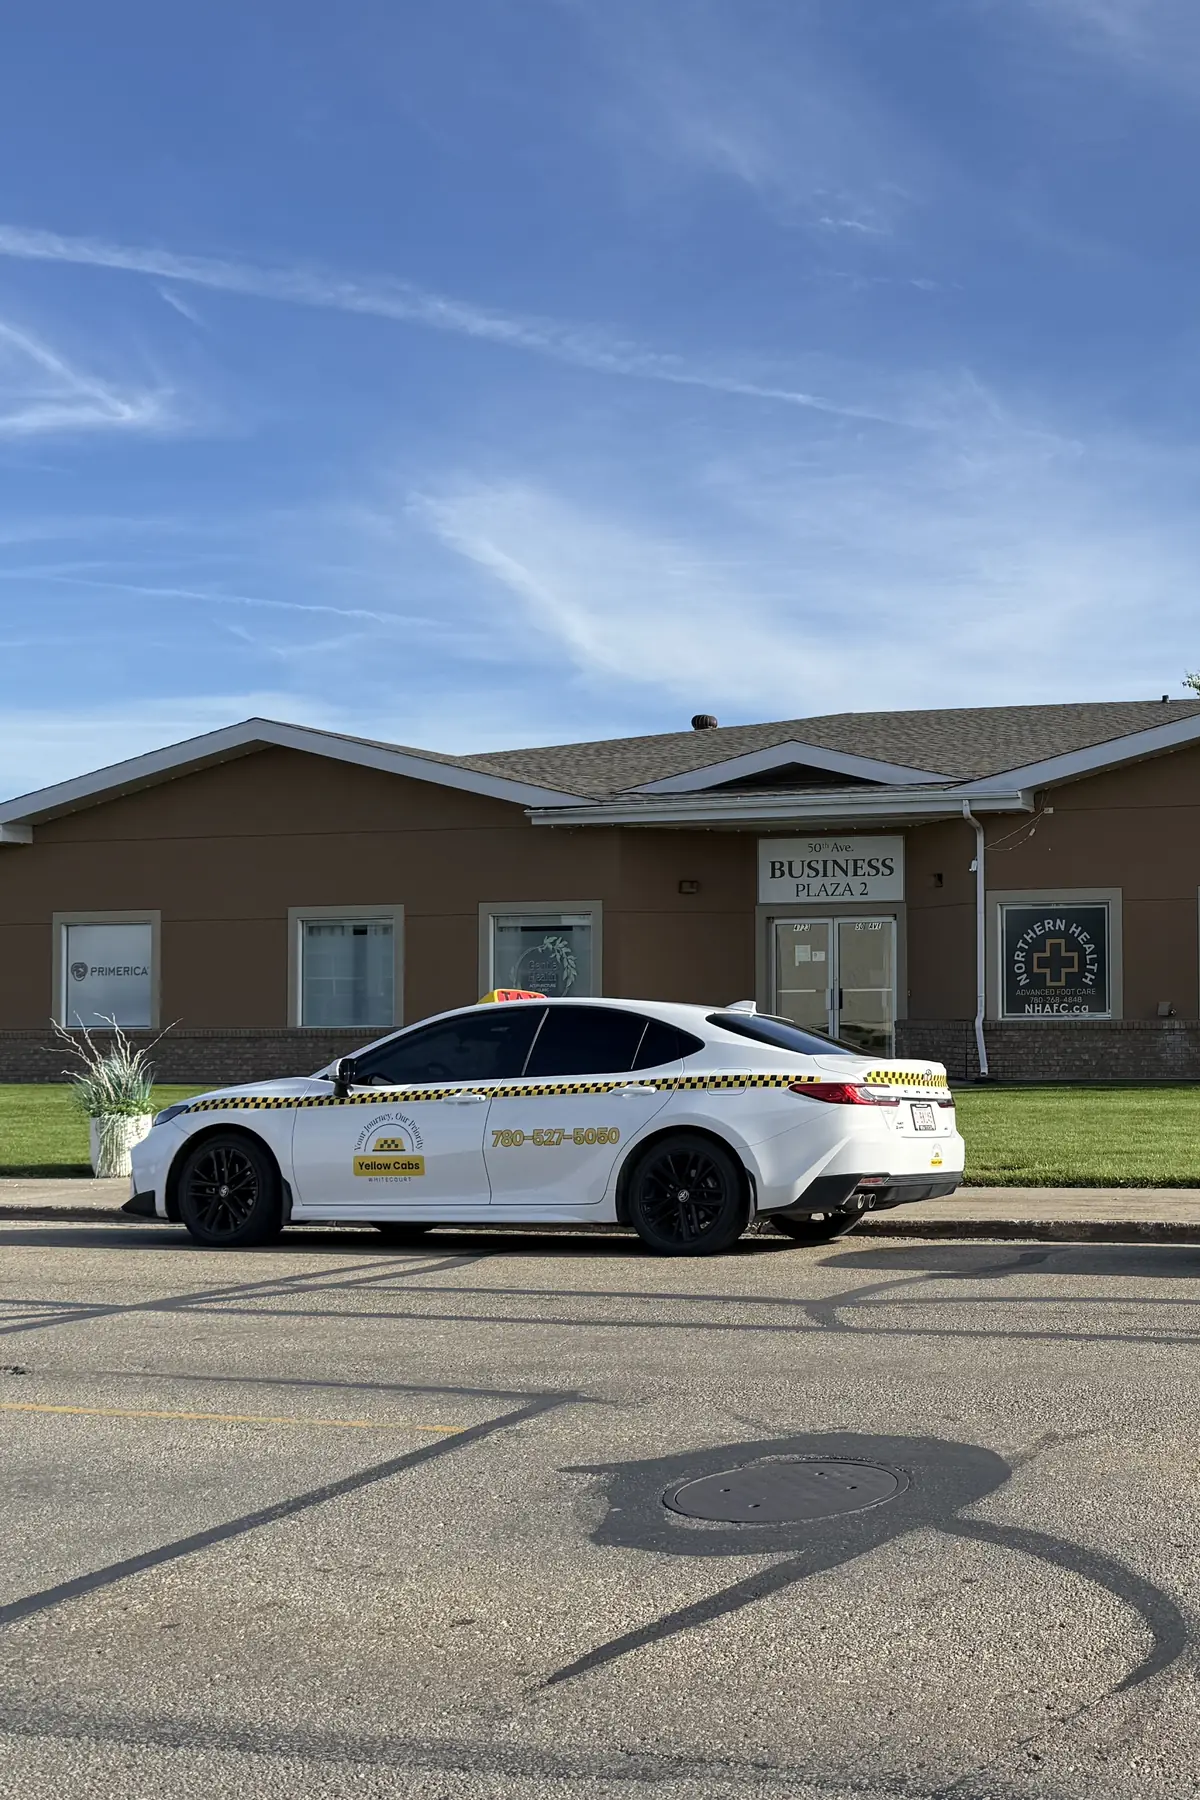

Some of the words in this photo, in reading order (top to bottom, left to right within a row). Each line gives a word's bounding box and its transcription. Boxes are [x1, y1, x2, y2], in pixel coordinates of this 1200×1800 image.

[808, 843, 830, 853] 50th
[831, 842, 854, 852] Ave.
[769, 858, 895, 879] BUSINESS
[796, 883, 854, 897] PLAZA
[859, 882, 869, 896] 2
[1014, 919, 1066, 986] NORTHERN
[1069, 923, 1098, 985] HEALTH
[90, 966, 148, 977] PRIMERICA
[501, 991, 545, 1000] TA
[1016, 988, 1055, 996] ADVANCED
[1057, 988, 1075, 996] FOOT
[1025, 1004, 1089, 1014] NHAFC.ca
[352, 1130, 366, 1151] Your
[363, 1112, 394, 1133] Journey,
[395, 1112, 410, 1124] Our
[408, 1120, 424, 1151] Priority
[491, 1127, 620, 1147] 780-527-5050
[358, 1161, 391, 1170] Yellow
[393, 1161, 420, 1170] Cabs
